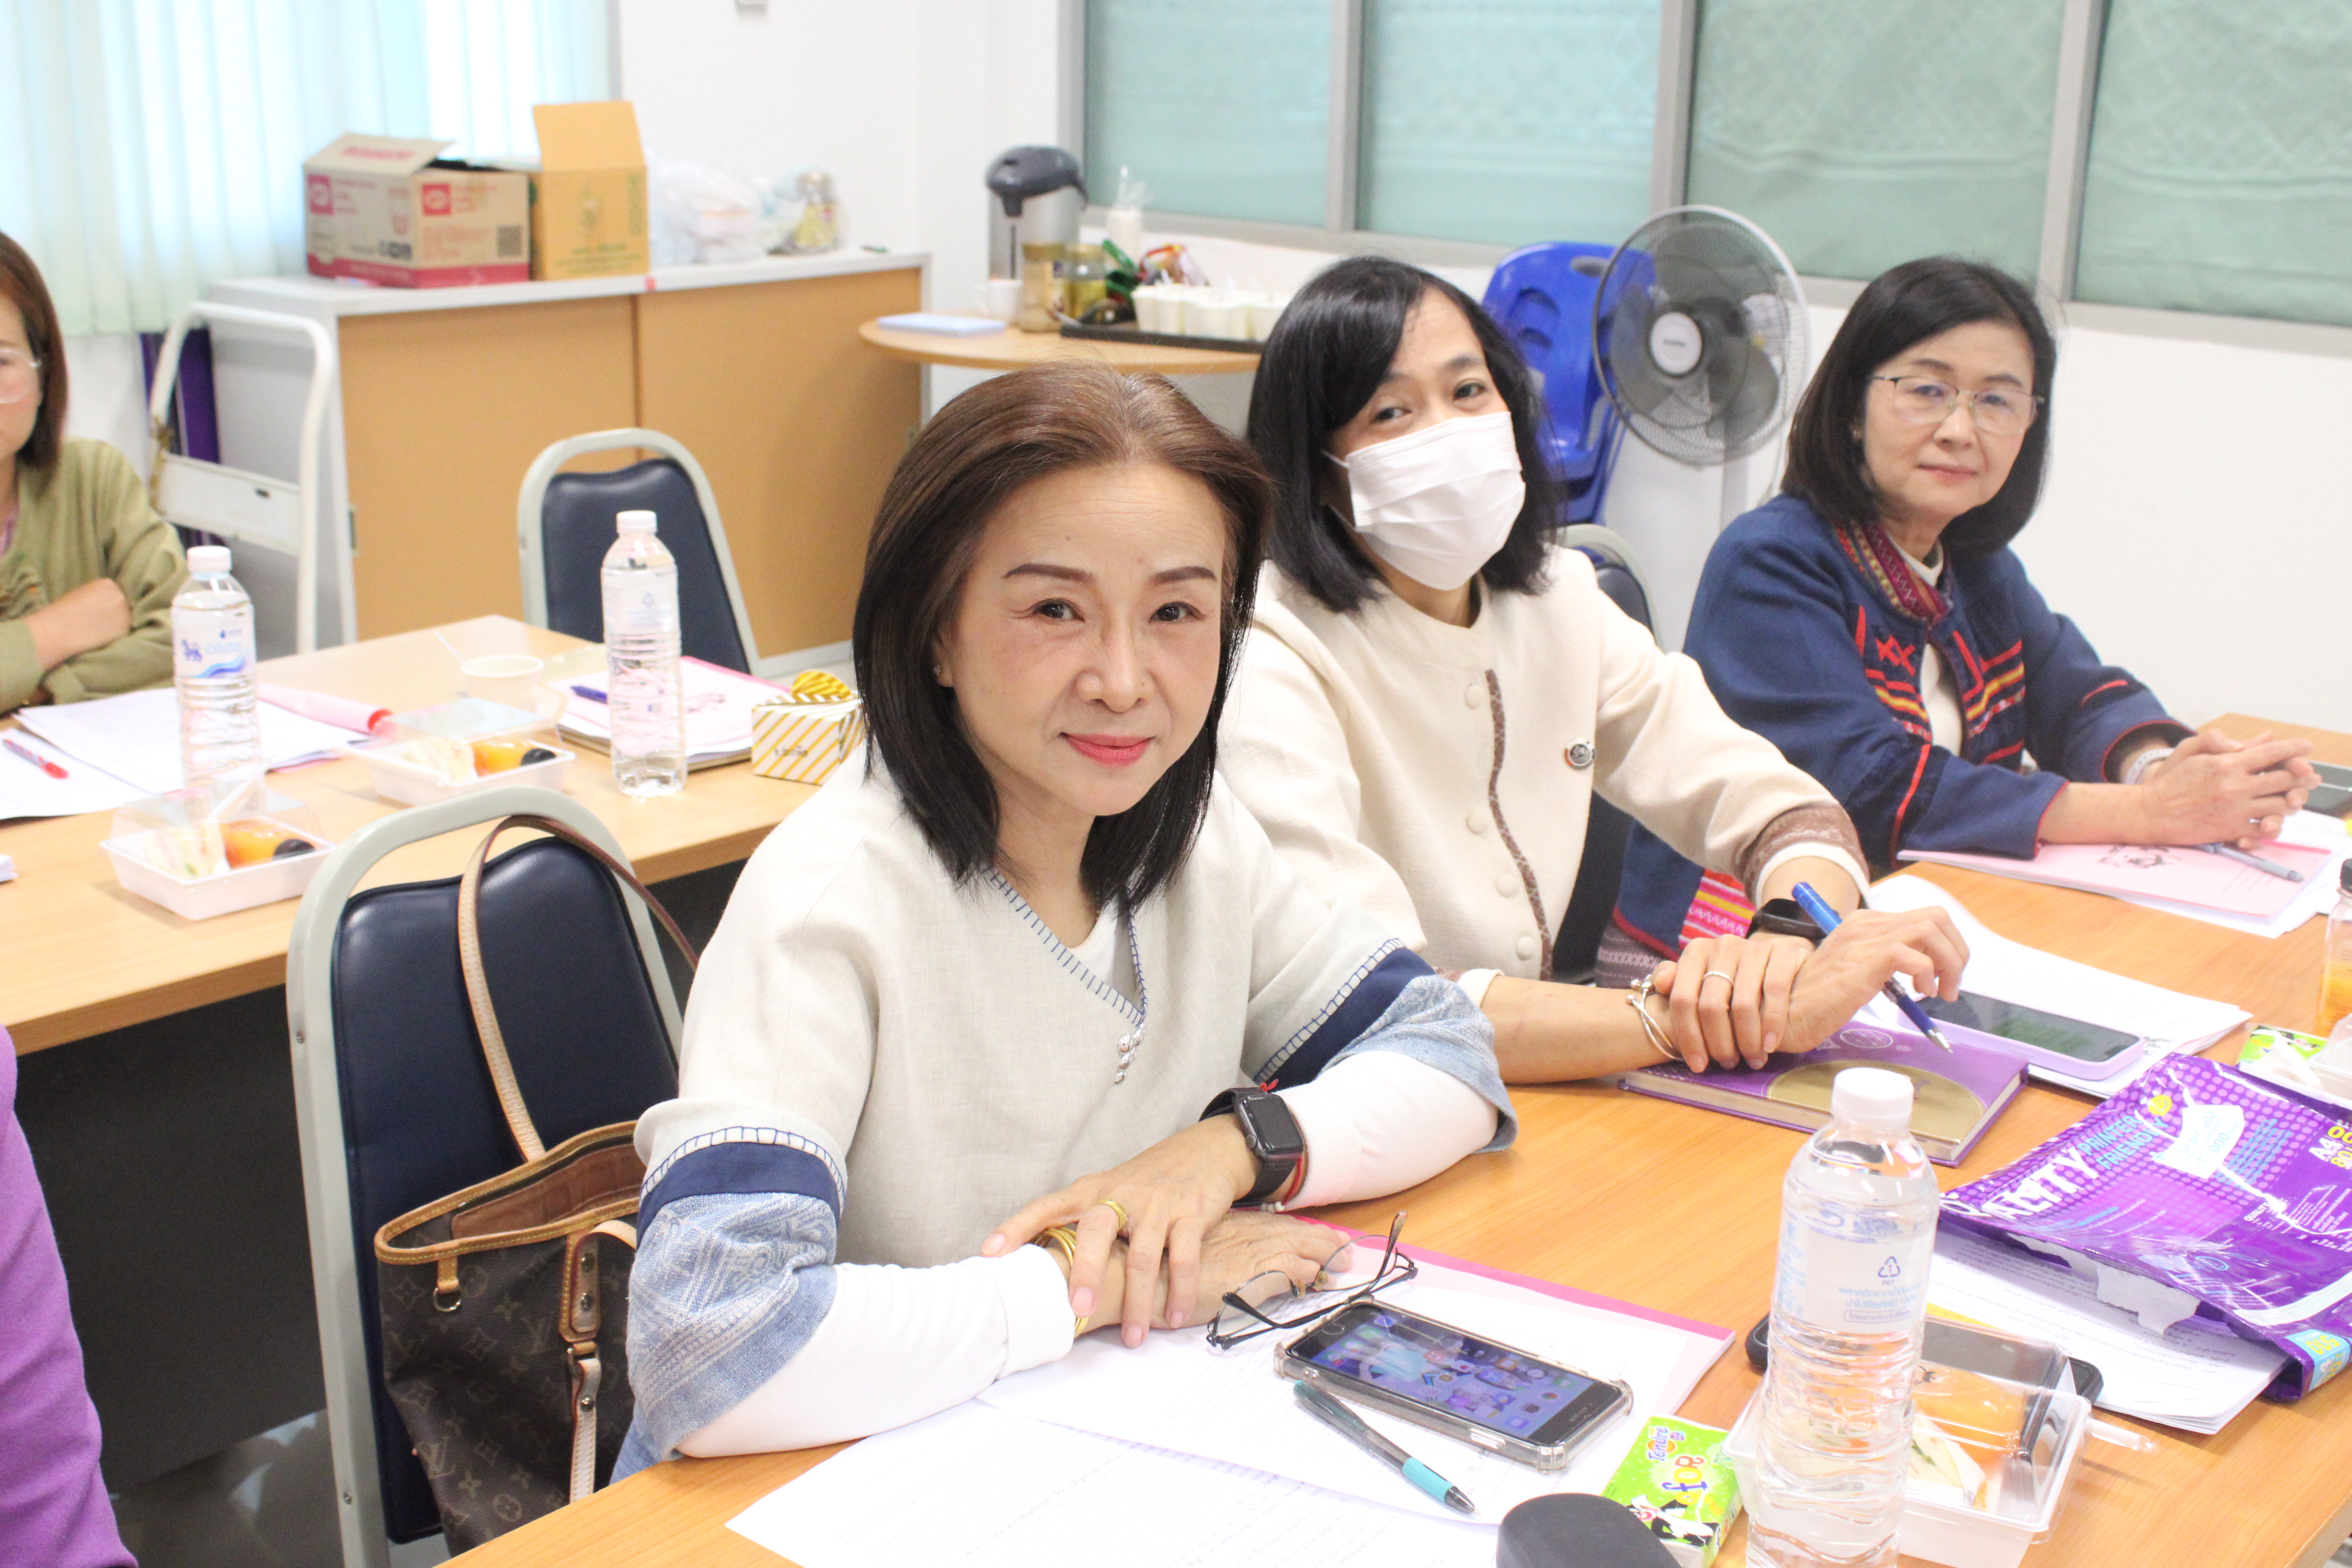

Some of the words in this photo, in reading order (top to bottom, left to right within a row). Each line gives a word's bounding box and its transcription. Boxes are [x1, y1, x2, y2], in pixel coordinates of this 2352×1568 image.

[2077, 1116, 2144, 1156] PRINTER
[2096, 1117, 2168, 1170] FRIENDLY
[2308, 1138, 2344, 1161] A4
[1939, 1146, 2099, 1220] QALITY
[2244, 1202, 2271, 1221] QUALITY
[2304, 1335, 2341, 1355] 500
[1648, 1426, 1668, 1461] Tendre
